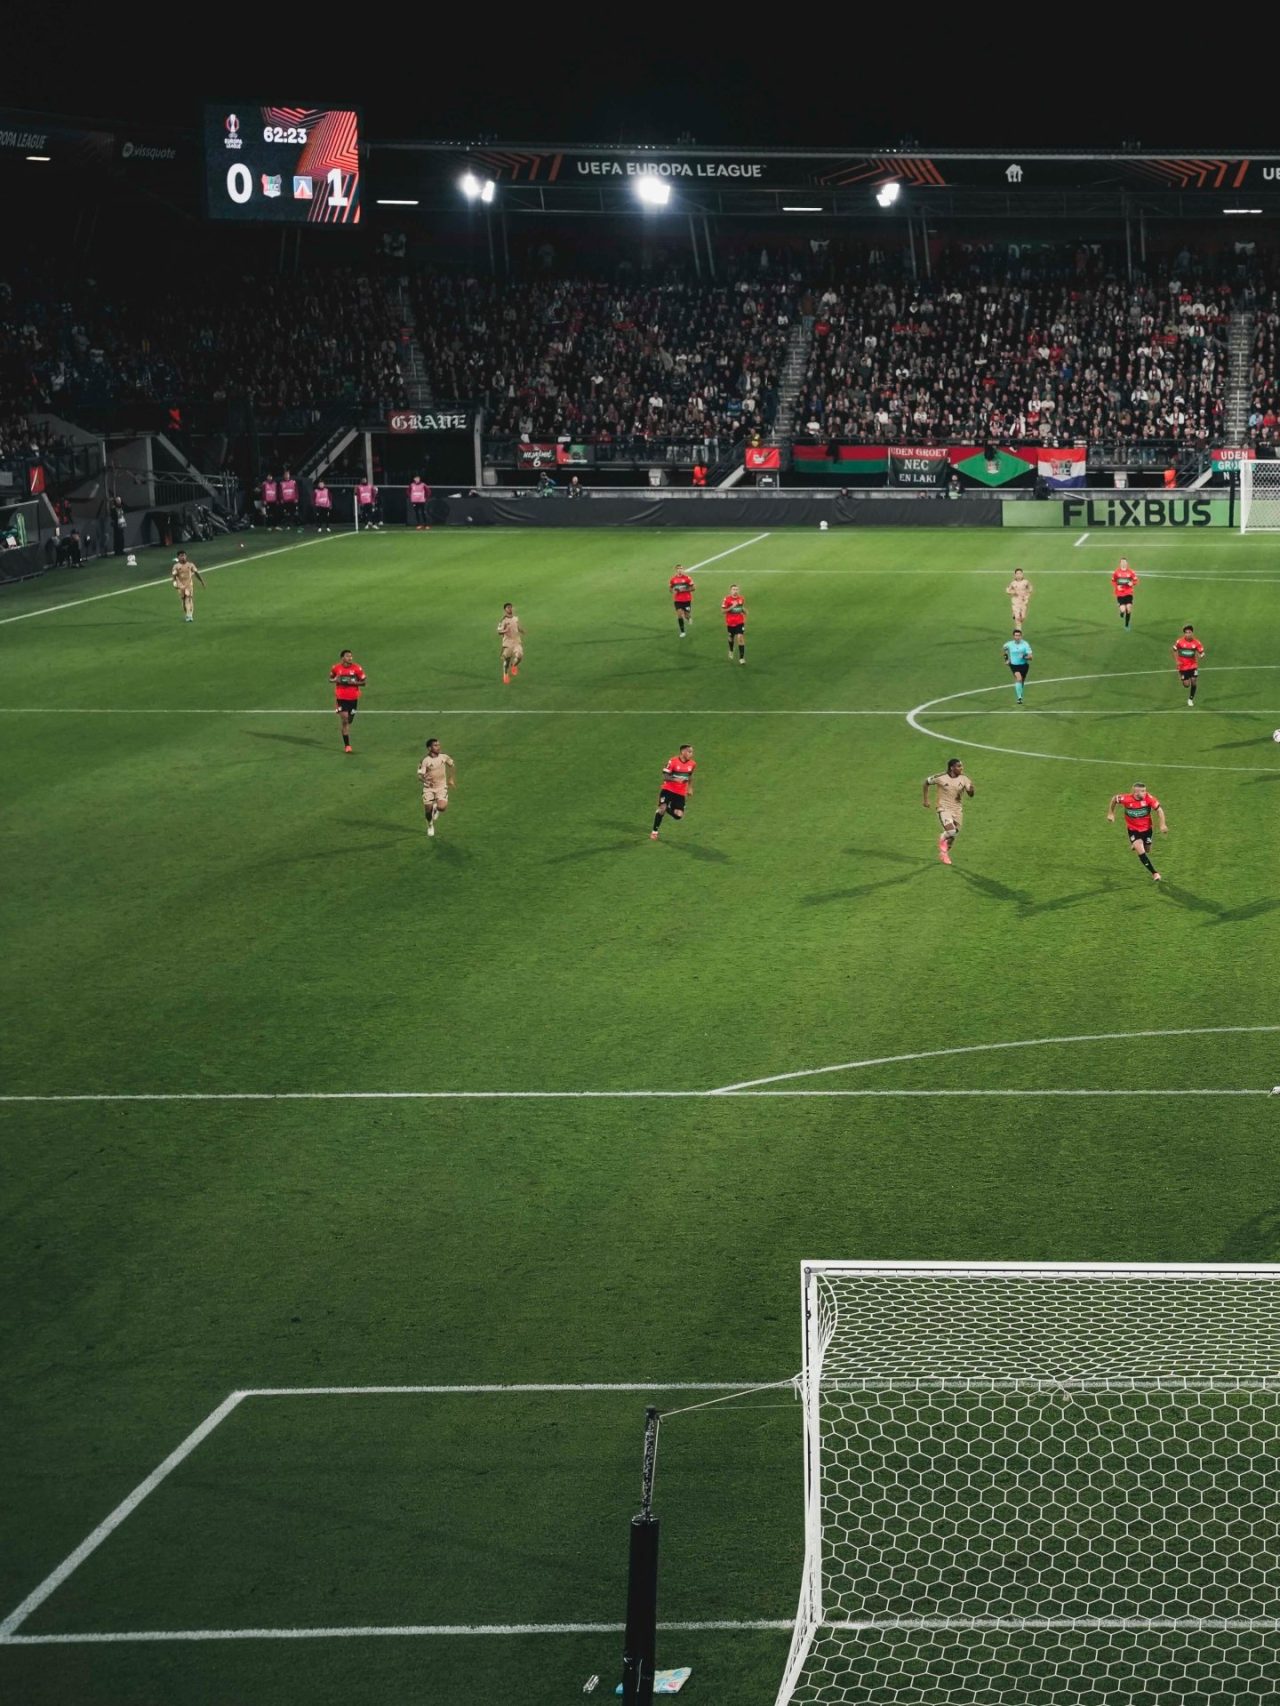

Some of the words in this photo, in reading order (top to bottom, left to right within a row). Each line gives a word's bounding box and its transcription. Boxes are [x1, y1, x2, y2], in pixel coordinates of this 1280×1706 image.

[263, 126, 307, 144] 62:23
[577, 161, 622, 175] UEFA
[626, 162, 693, 176] EUROPA
[698, 164, 762, 177] LEAGUE
[227, 163, 253, 204] 0
[327, 168, 349, 206] 1
[916, 448, 948, 457] GROET
[1220, 450, 1249, 460] UDEN
[904, 459, 929, 471] NEC
[899, 473, 911, 482] EN
[913, 474, 936, 483] LAKI
